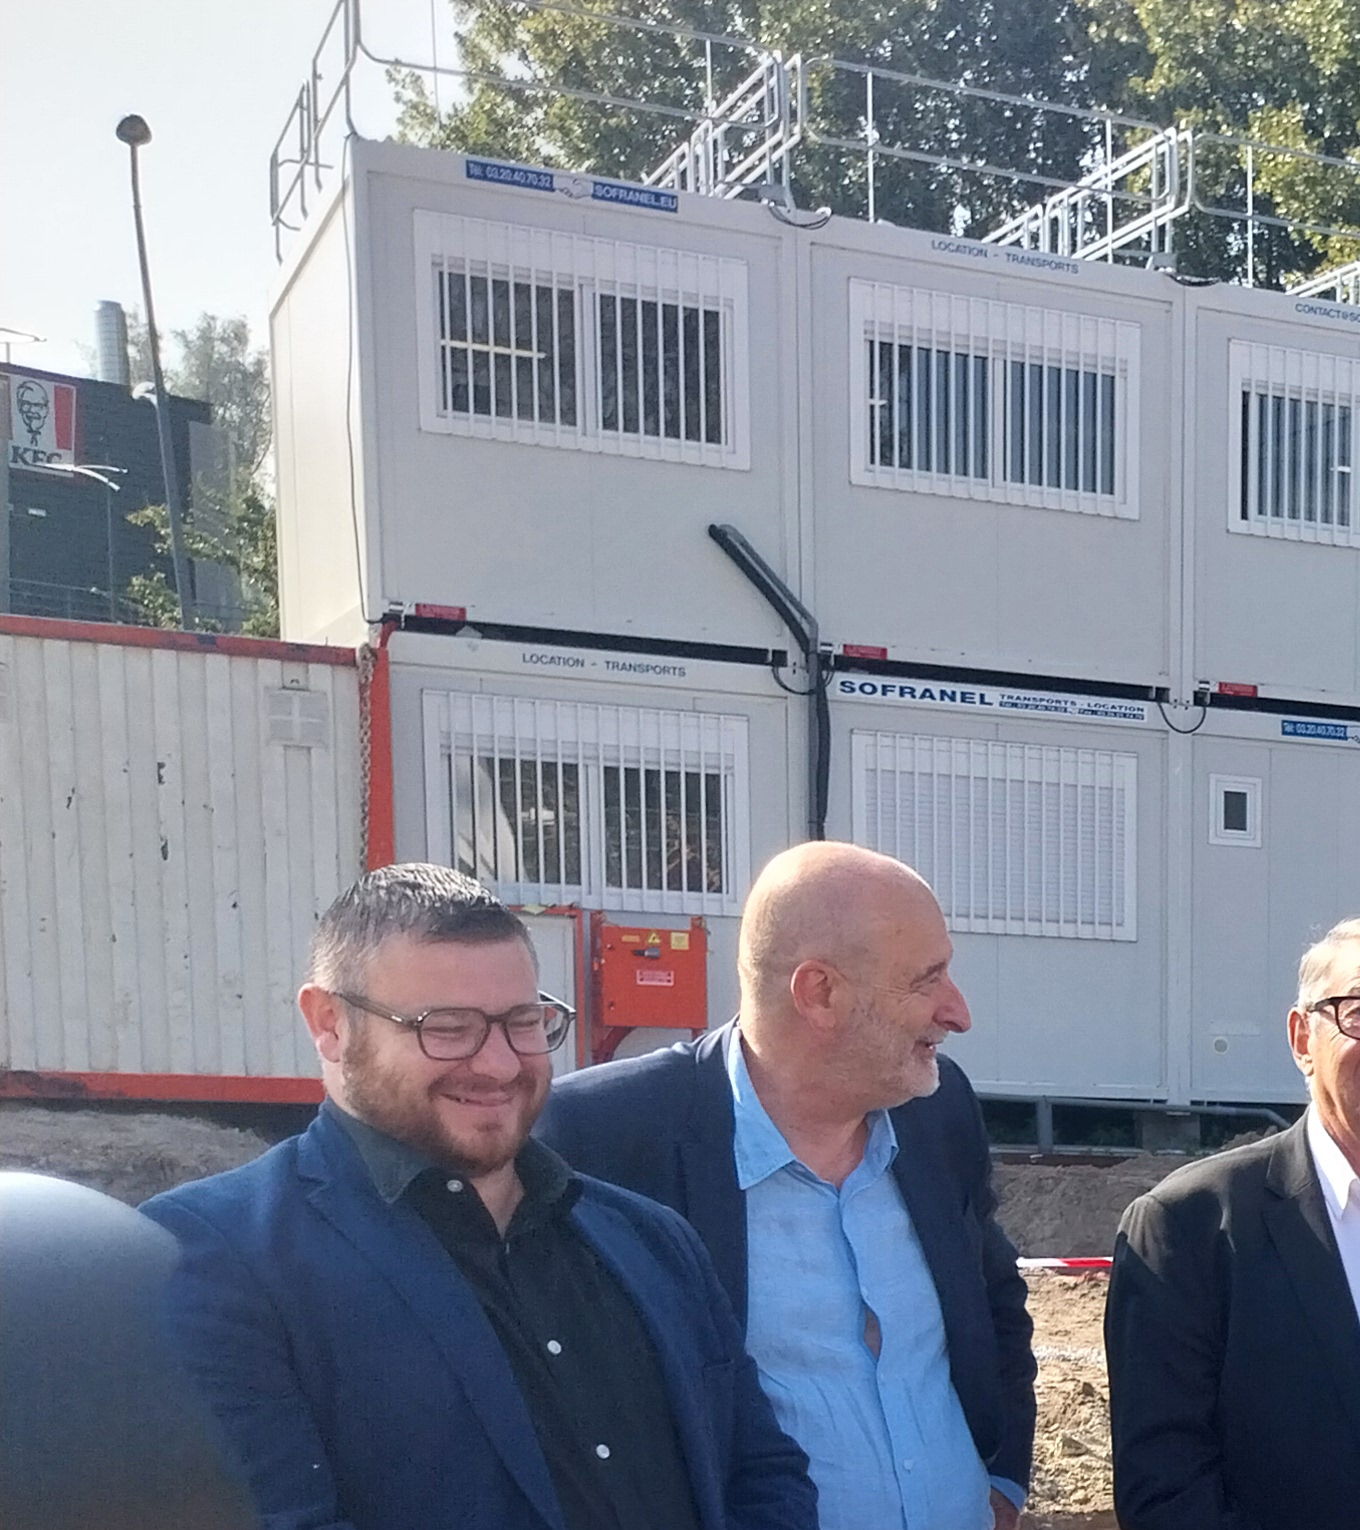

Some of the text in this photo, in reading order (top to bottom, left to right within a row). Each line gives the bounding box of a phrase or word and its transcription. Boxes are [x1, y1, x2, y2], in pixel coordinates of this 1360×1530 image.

[595, 184, 678, 210] SOFRANEL.EU
[931, 240, 988, 258] LOCATION
[1004, 252, 1079, 274] TRANSPORTS
[522, 653, 585, 668] LOCATION
[604, 660, 686, 677] TRANSPORTS
[839, 680, 994, 706] SOFRANEL
[1000, 694, 1077, 707] TRANSPORTS
[1087, 702, 1145, 713] LOCATION
